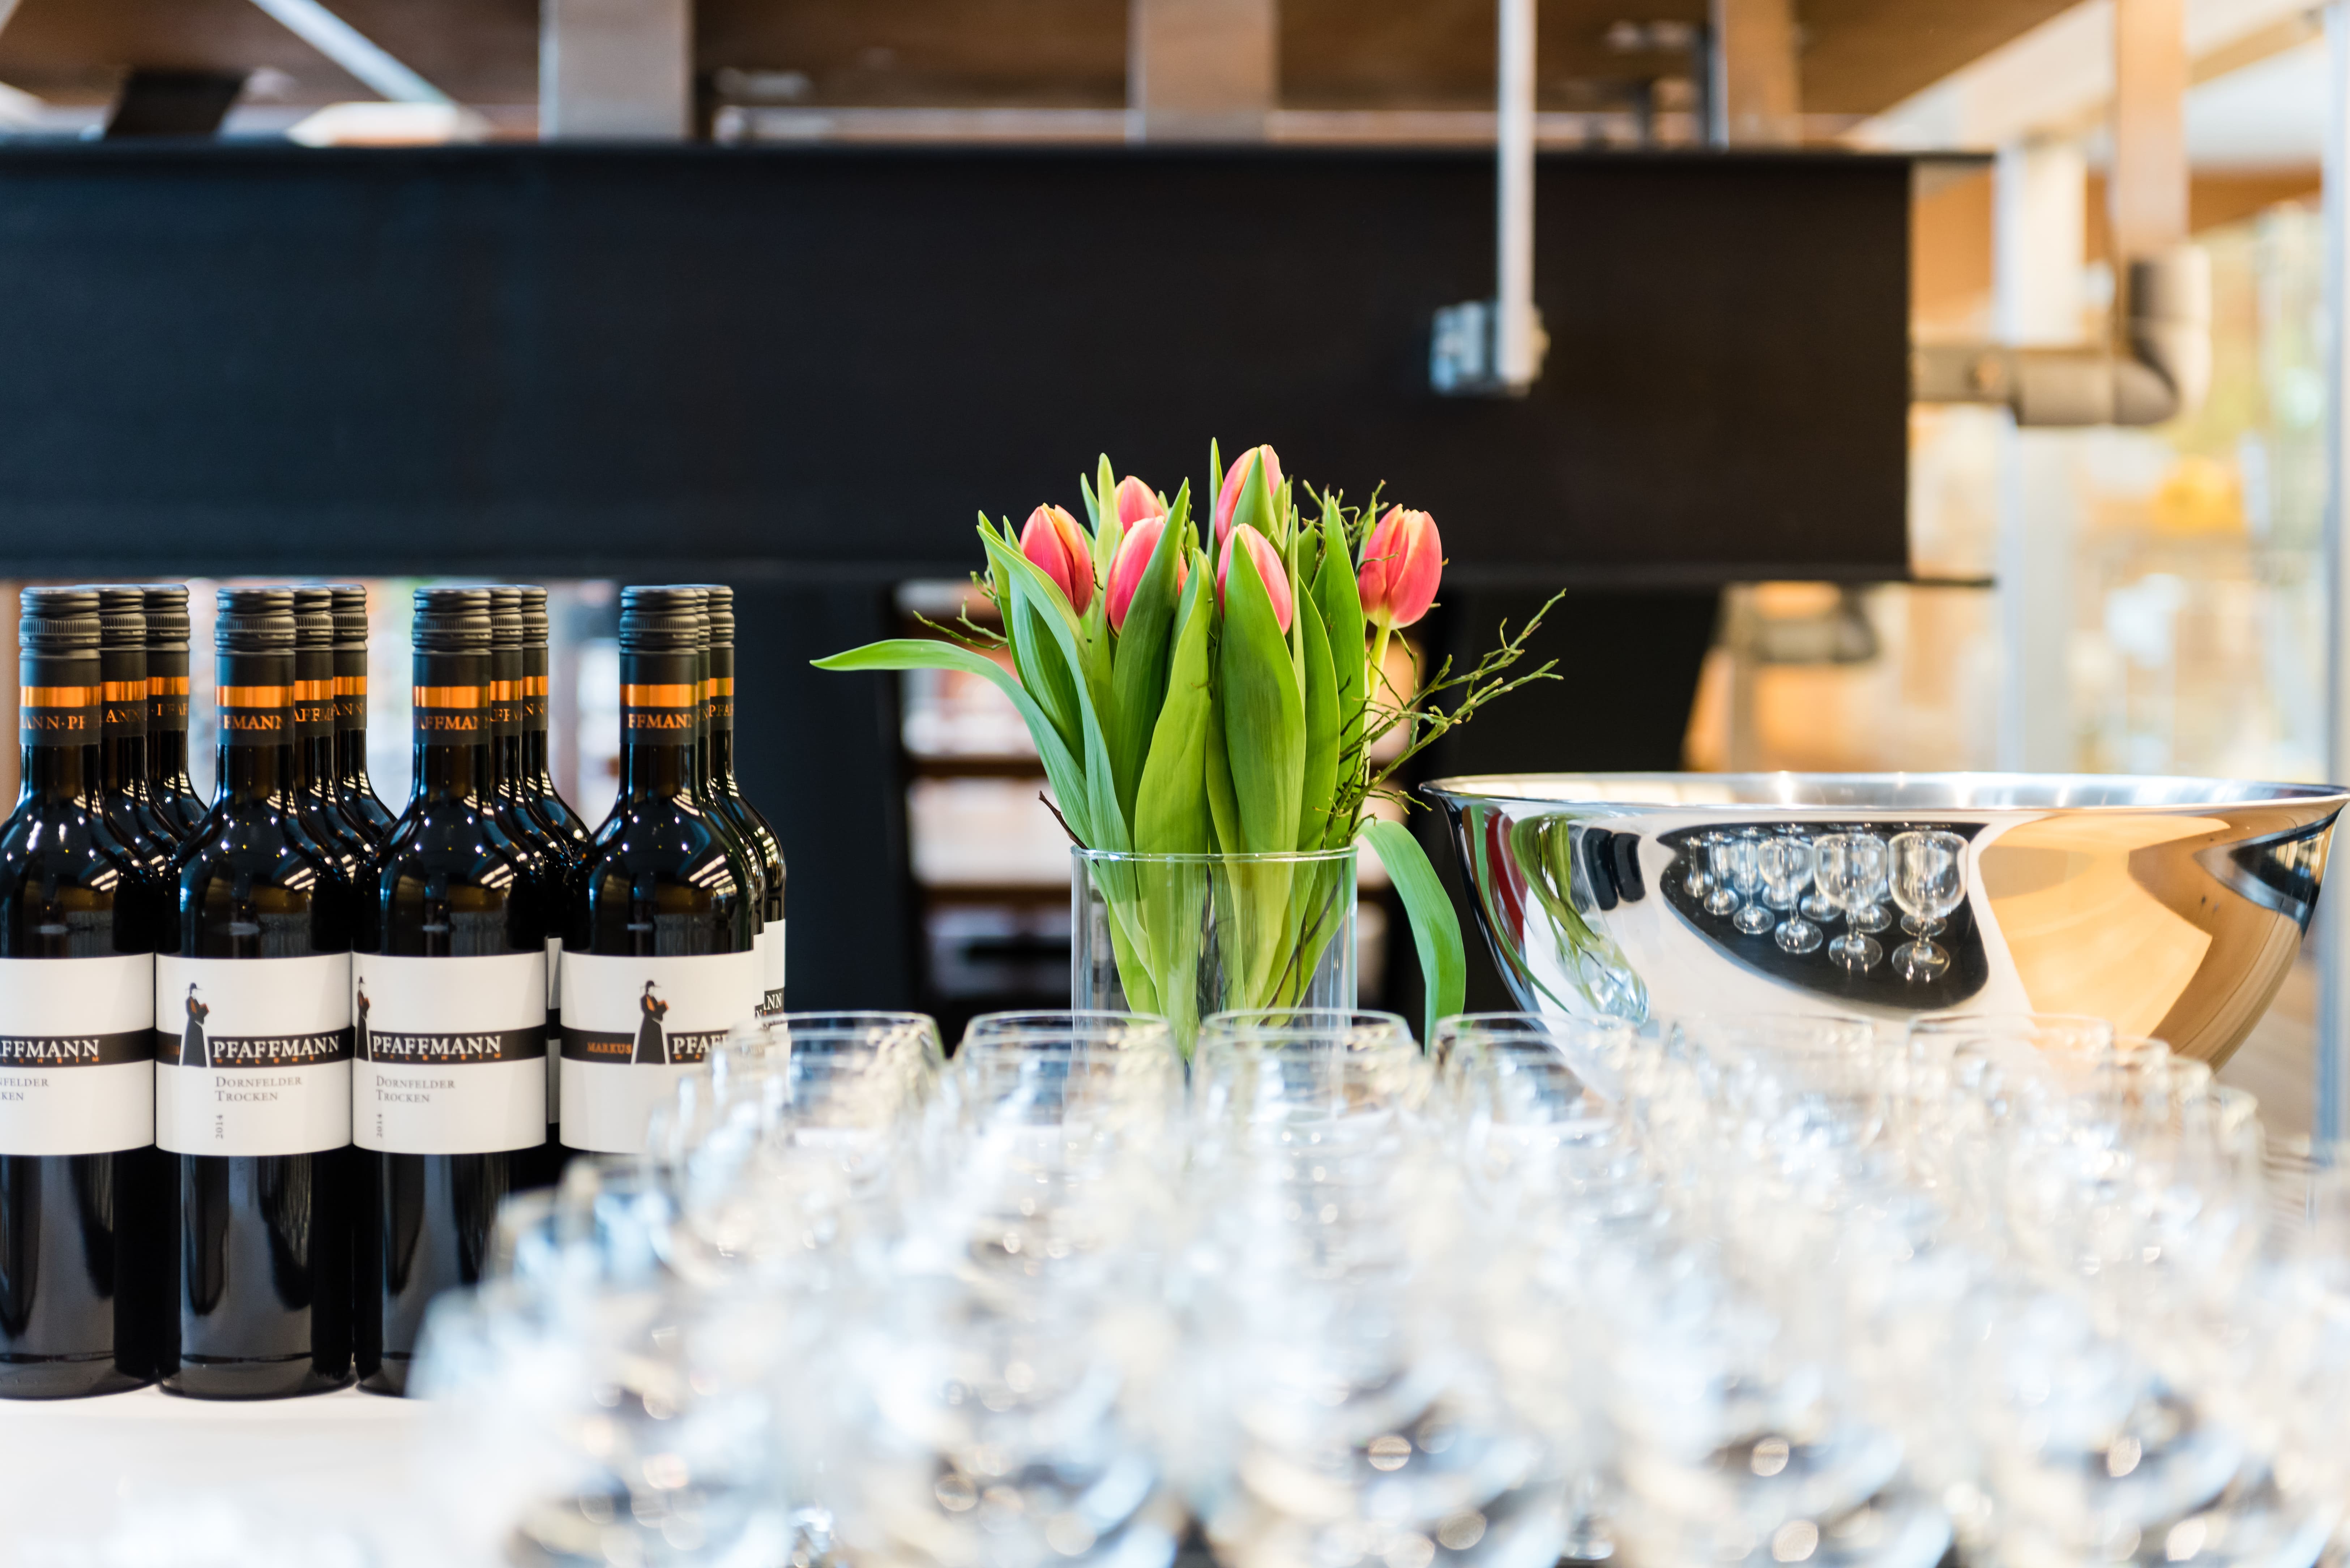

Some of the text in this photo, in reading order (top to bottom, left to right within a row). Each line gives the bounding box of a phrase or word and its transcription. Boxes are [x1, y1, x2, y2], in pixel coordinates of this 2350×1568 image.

[0, 1040, 99, 1058] FFMANN
[213, 1035, 339, 1058] PFAFFMANN
[373, 1036, 501, 1055] PFAFFMANN
[587, 1042, 632, 1055] MARKUS
